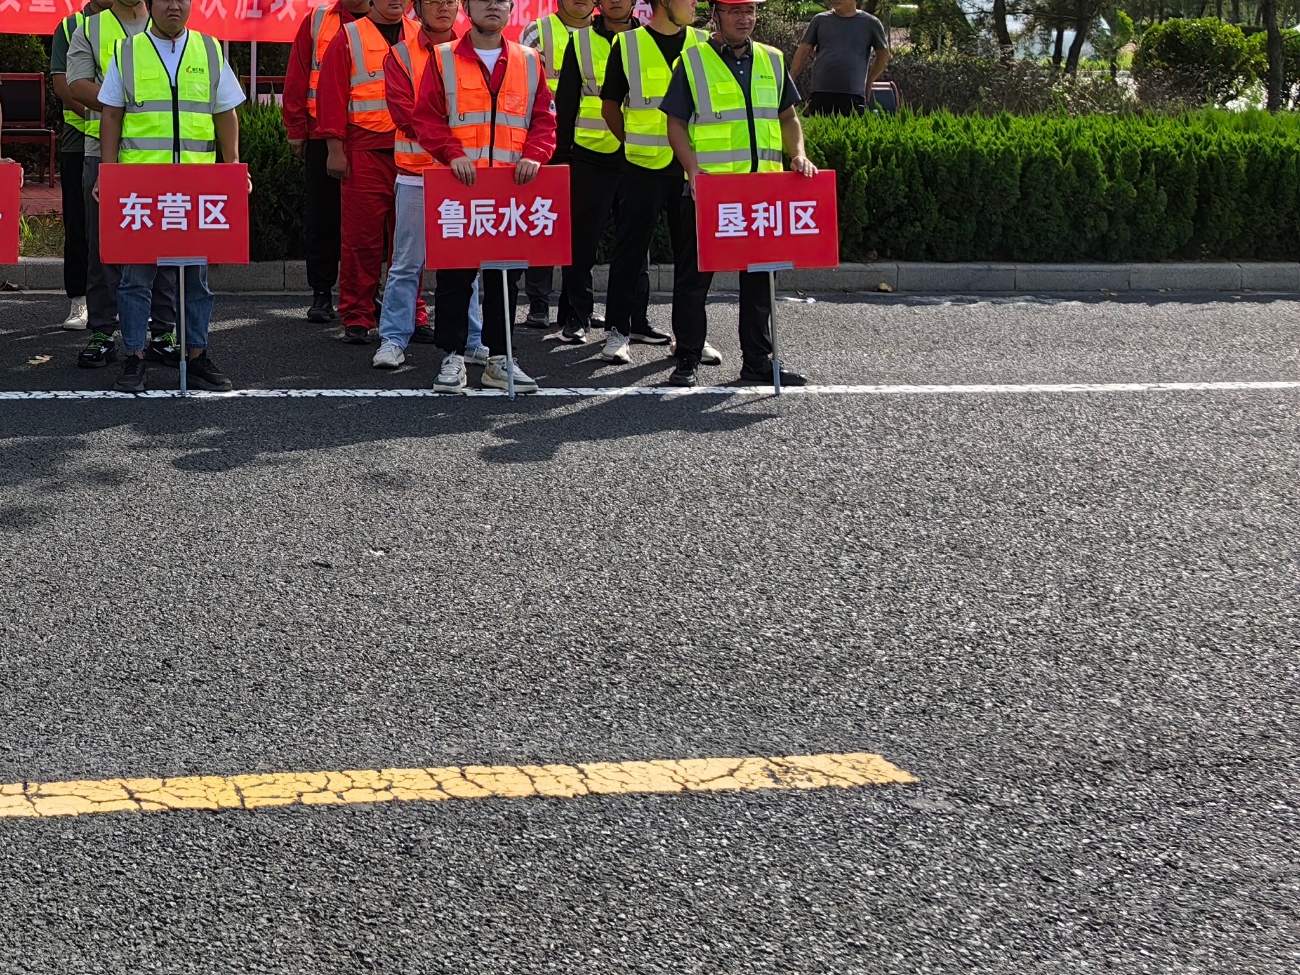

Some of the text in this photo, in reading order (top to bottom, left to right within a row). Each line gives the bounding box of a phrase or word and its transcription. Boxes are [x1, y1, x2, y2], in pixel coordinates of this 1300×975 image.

[119, 193, 230, 231] 东营区
[437, 196, 558, 238] 鲁辰水务
[714, 200, 820, 237] 垦利区
